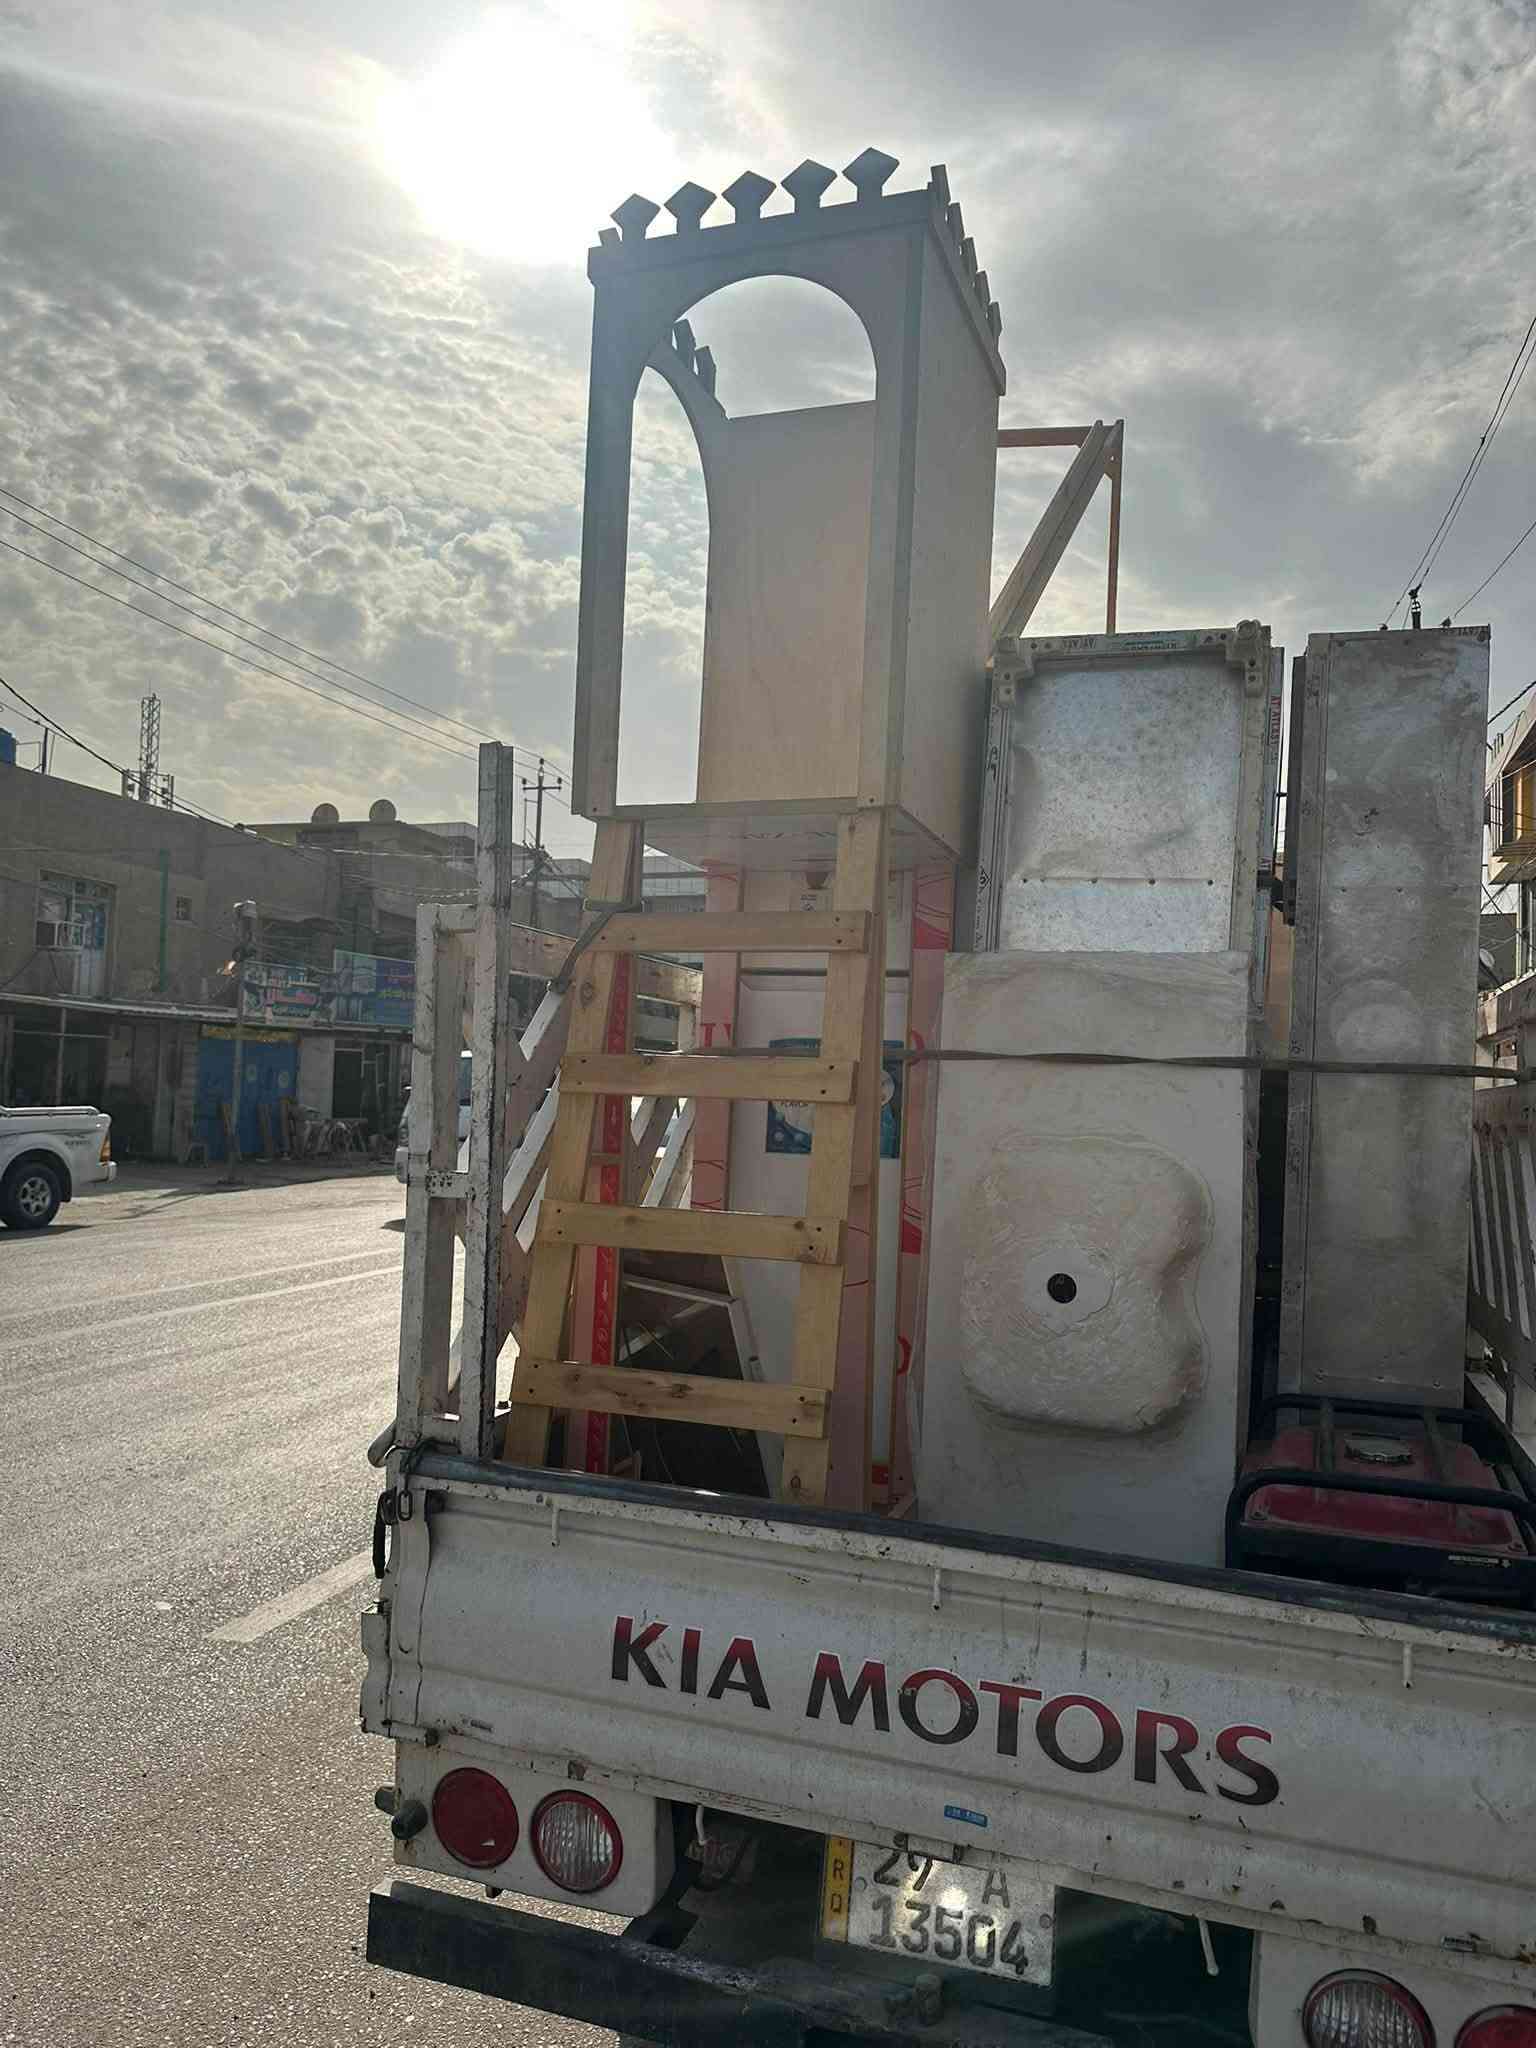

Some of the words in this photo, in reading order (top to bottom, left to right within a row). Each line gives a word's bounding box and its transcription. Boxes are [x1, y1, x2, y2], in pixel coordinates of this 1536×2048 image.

[610, 1614, 772, 1710] KIA
[805, 1650, 1281, 1806] MOTORS
[982, 1868, 1010, 1908] A
[869, 1894, 1029, 1976] 13504
